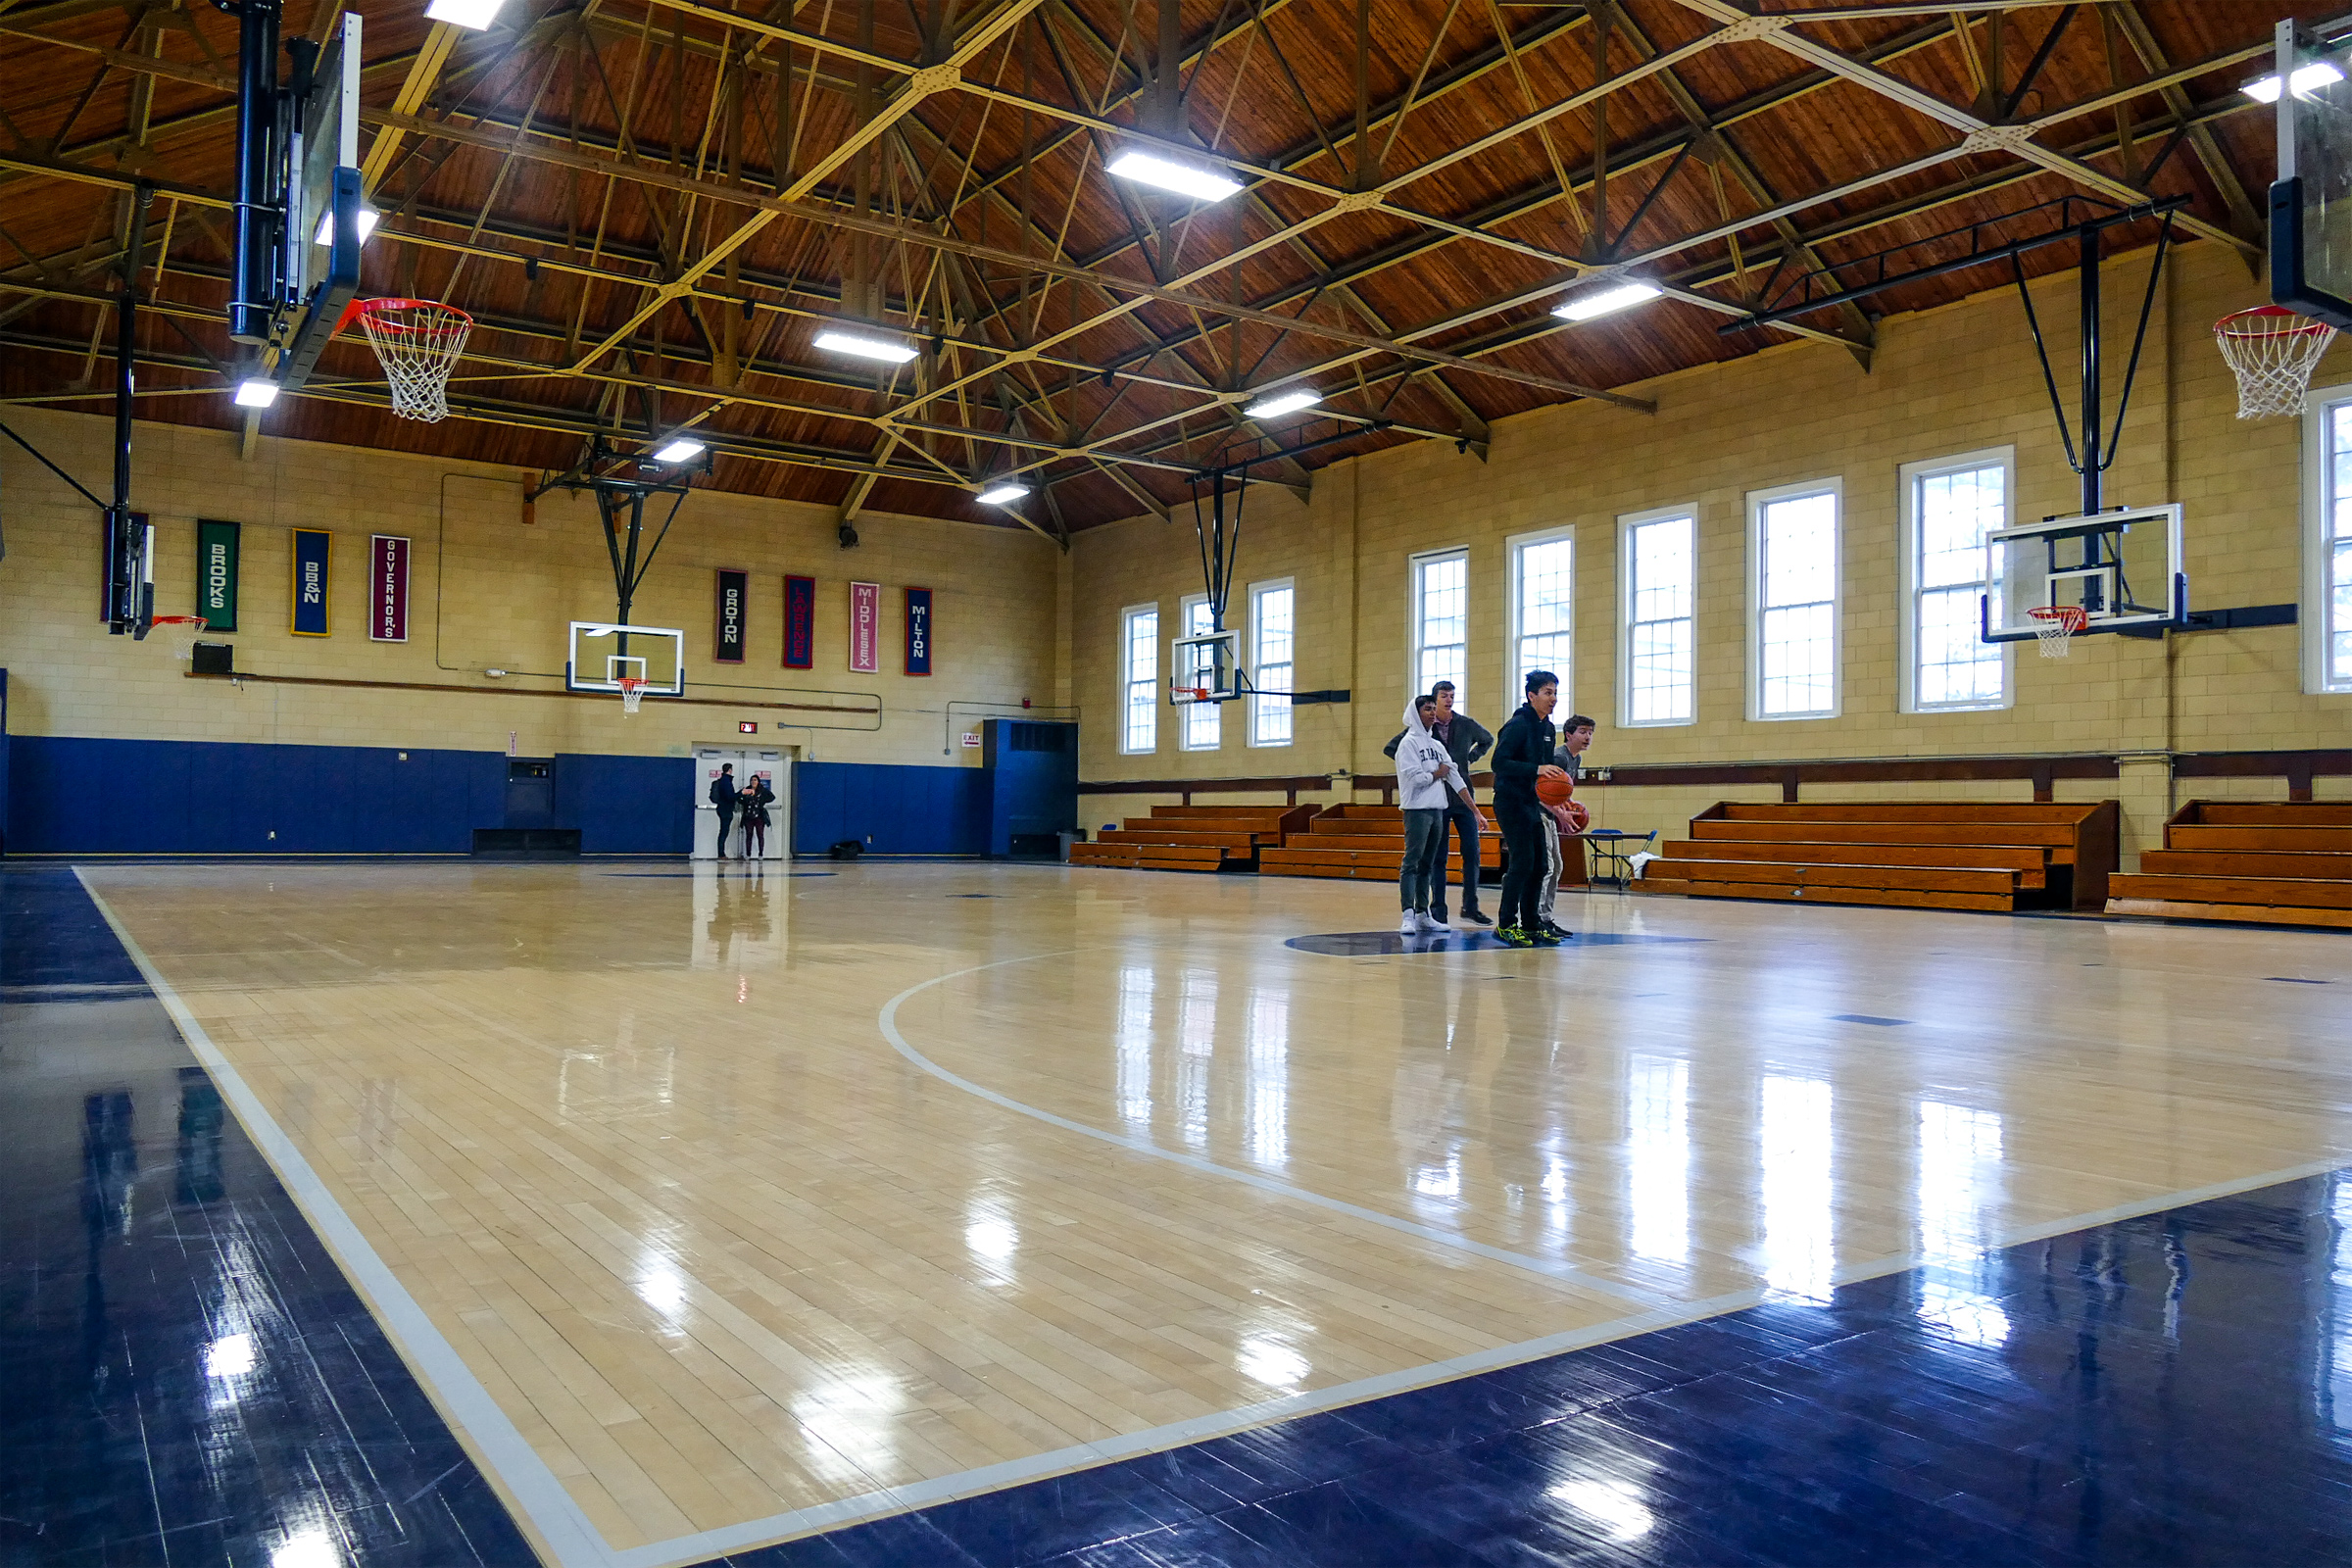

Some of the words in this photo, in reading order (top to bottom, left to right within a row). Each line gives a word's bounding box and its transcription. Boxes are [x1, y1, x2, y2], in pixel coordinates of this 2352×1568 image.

[209, 543, 226, 610] BROOKS
[303, 561, 321, 604] BB&N
[384, 540, 396, 638] GOVERNOR'S
[724, 588, 738, 644] GROTON
[793, 587, 808, 659] LAWRENCE
[858, 587, 872, 666] MIDDLESEX
[911, 605, 926, 659] MILTON
